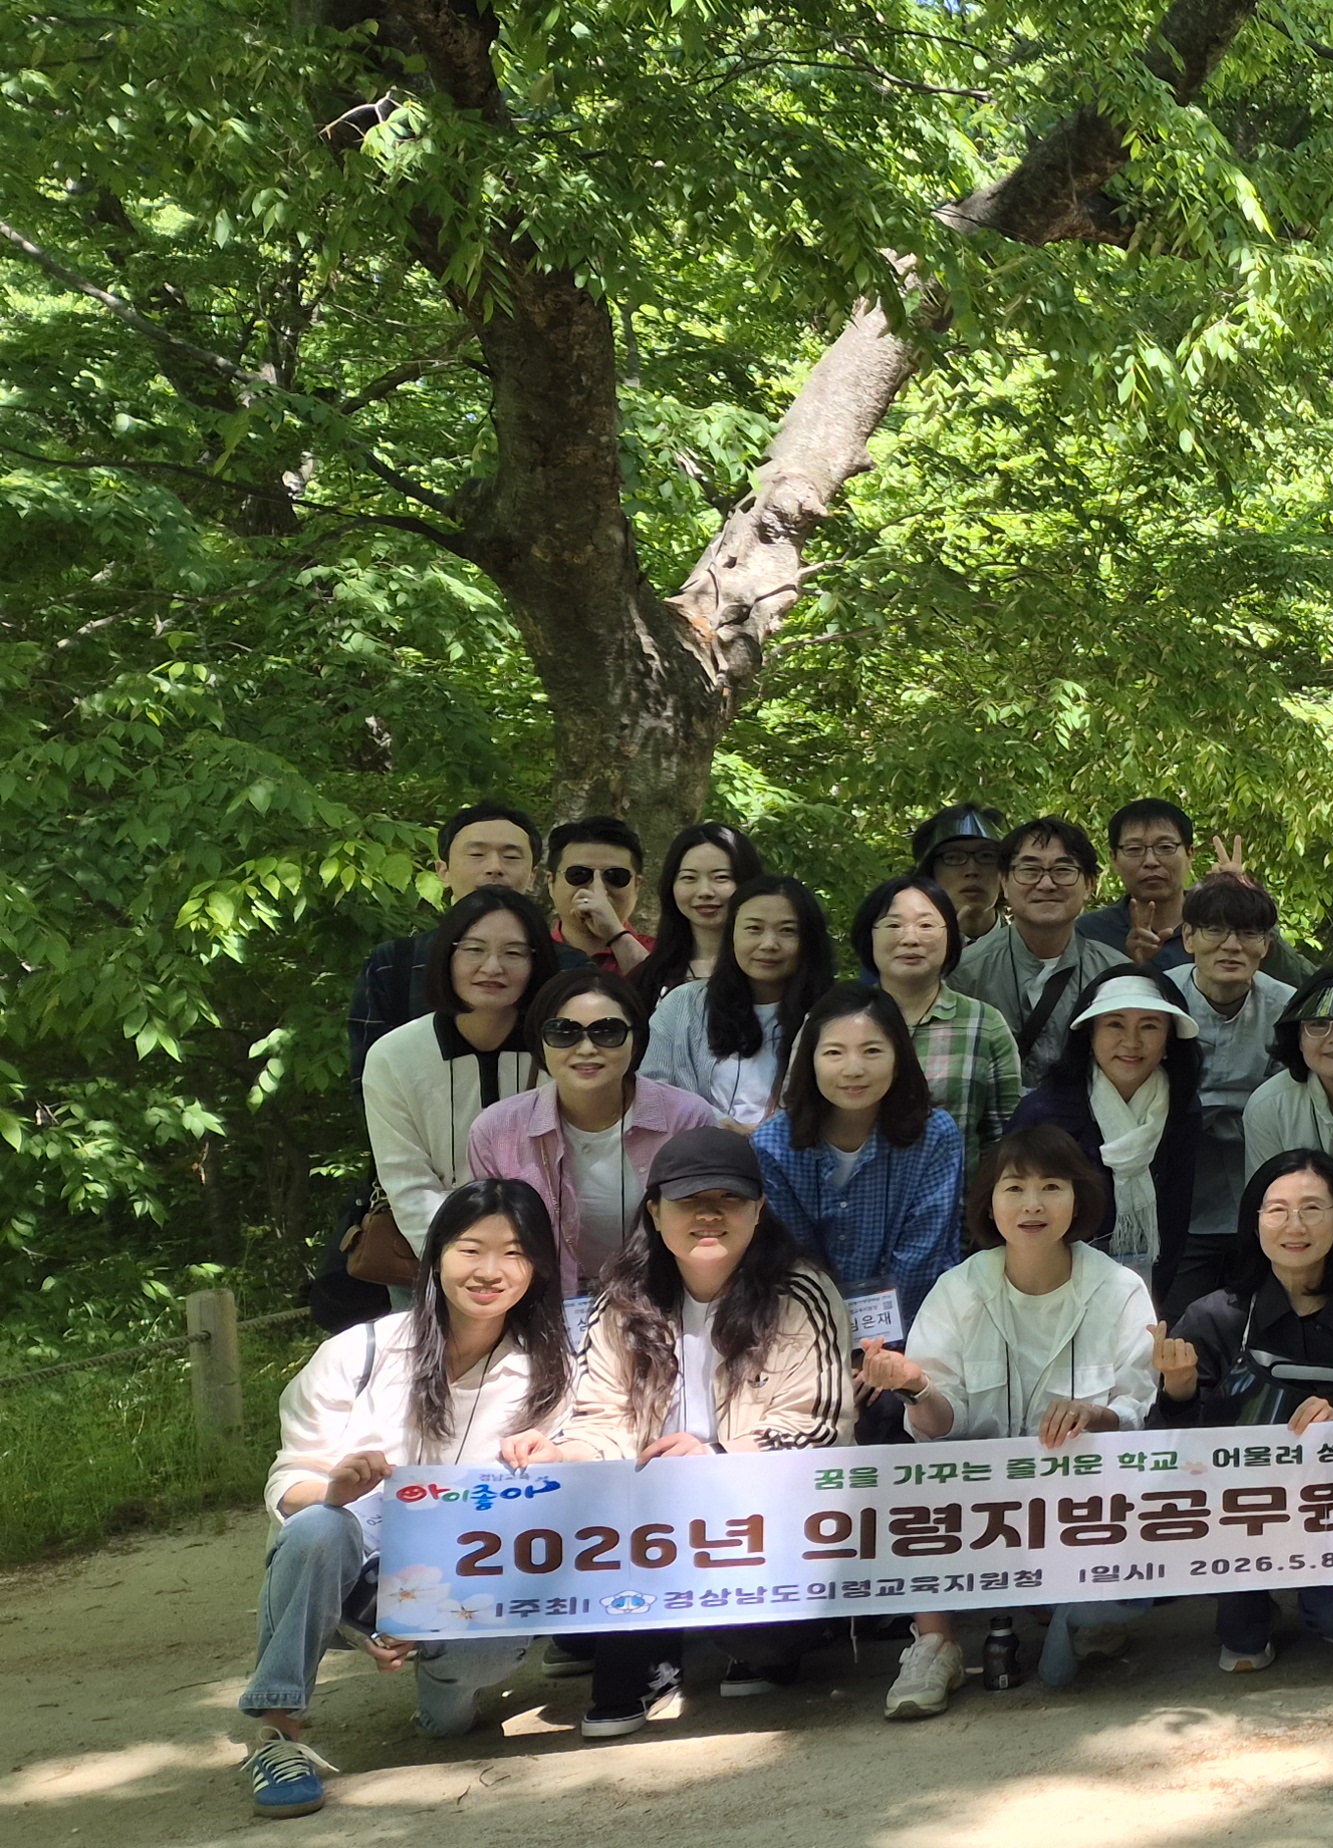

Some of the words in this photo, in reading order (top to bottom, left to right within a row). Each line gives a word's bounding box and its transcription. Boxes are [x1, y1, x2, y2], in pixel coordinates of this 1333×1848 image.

[814, 1466, 879, 1490] 꿈을
[893, 1460, 992, 1485] 가꾸는
[1006, 1454, 1103, 1479] 즐거운
[1117, 1451, 1179, 1472] 학교
[1212, 1444, 1303, 1468] 어울려
[396, 1480, 561, 1511] 아이좋아
[455, 1514, 766, 1577] 2026년
[664, 1568, 1043, 1610] 경상남도의령교육지원청
